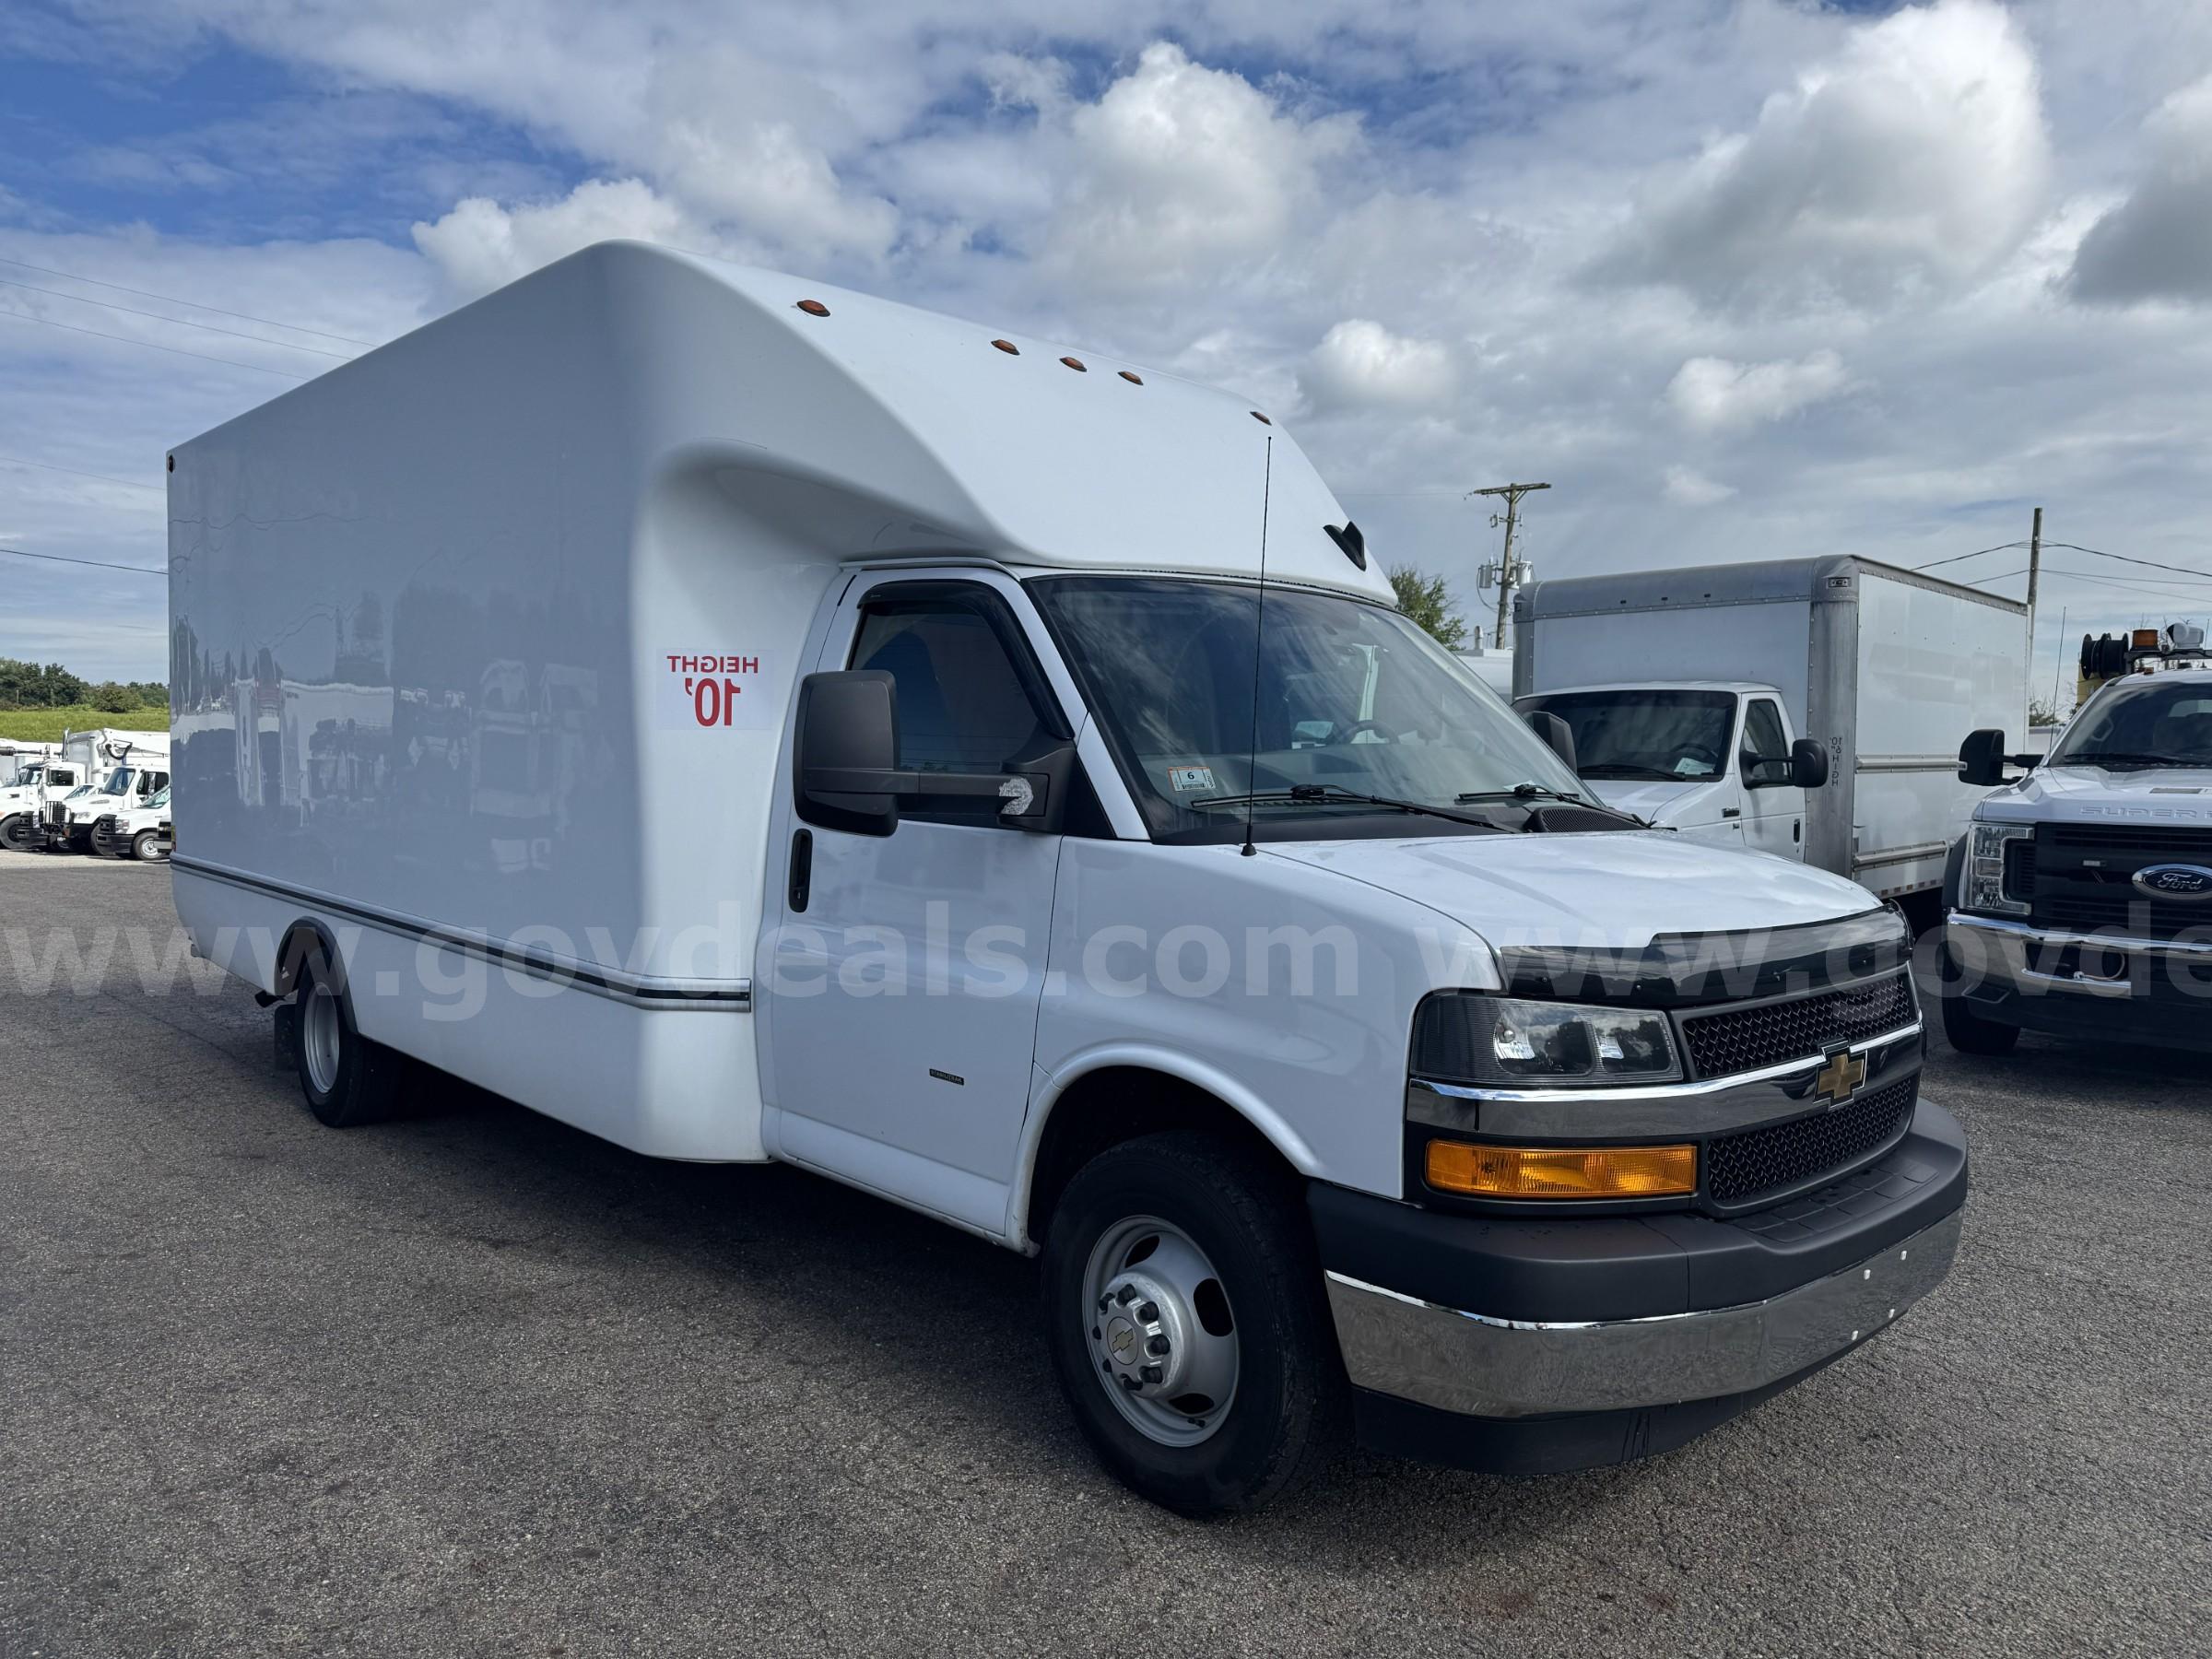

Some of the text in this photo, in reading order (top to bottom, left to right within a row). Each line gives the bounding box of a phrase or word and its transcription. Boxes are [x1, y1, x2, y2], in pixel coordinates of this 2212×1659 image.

[1187, 771, 1194, 780] 6
[2079, 806, 2198, 819] SUPER
[2157, 872, 2204, 890] Ford
